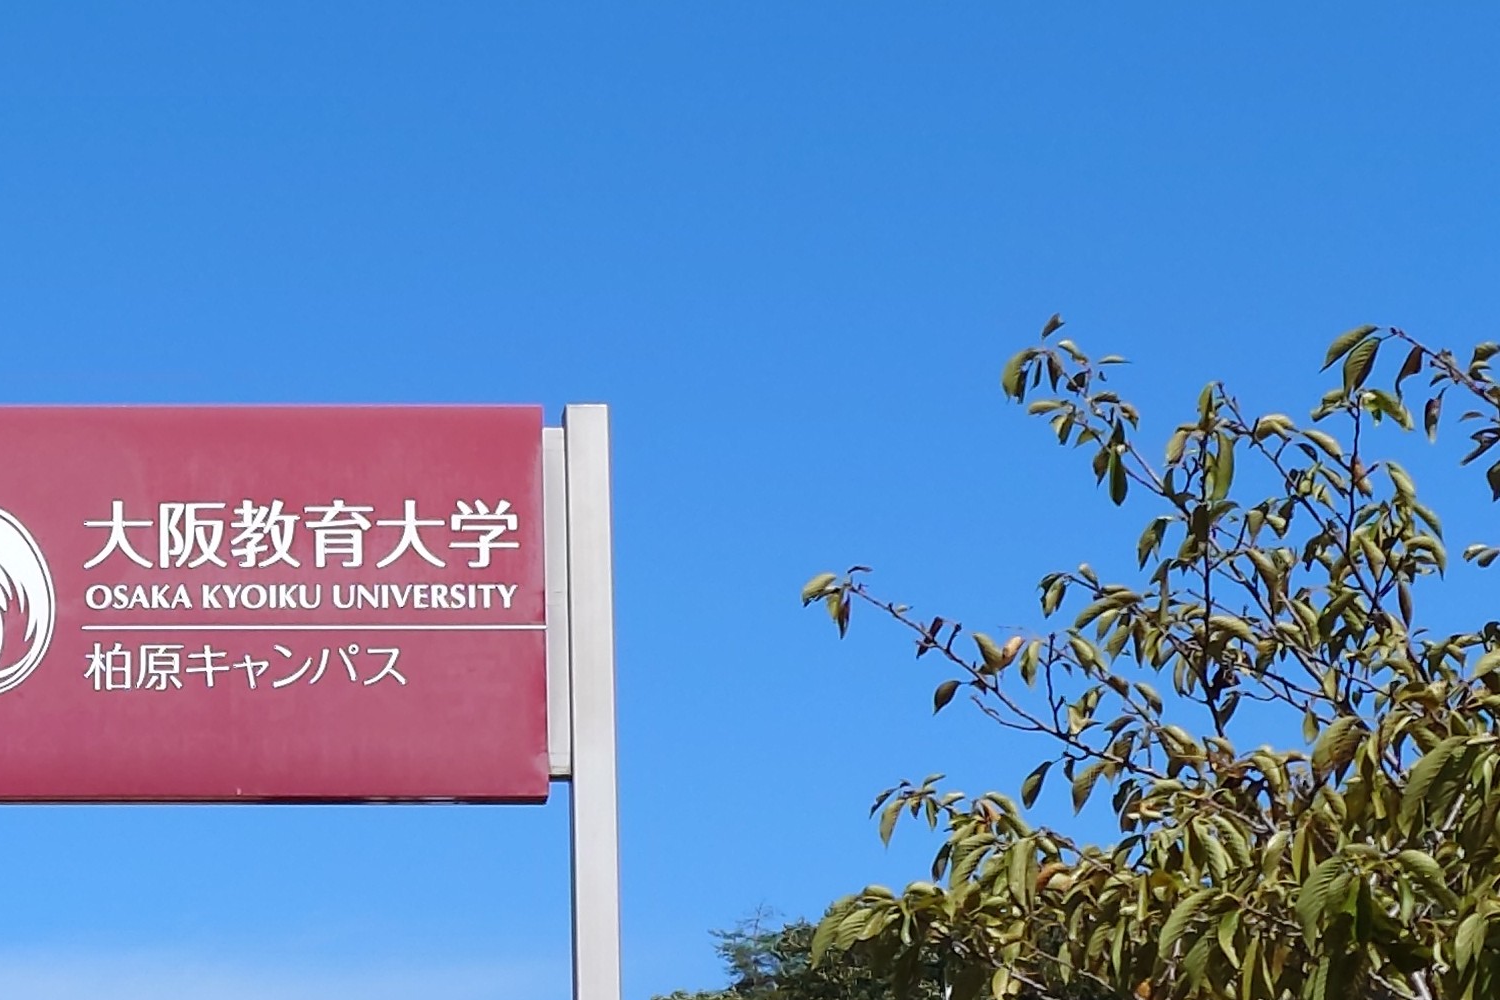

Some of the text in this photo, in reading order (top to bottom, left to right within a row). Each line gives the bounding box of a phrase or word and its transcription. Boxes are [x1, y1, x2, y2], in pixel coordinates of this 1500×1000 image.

[82, 499, 521, 570] 大阪教育大学
[84, 582, 519, 610] OSAKA KYOIKU UNIVERSITY
[82, 642, 408, 691] 柏原キャンパス
